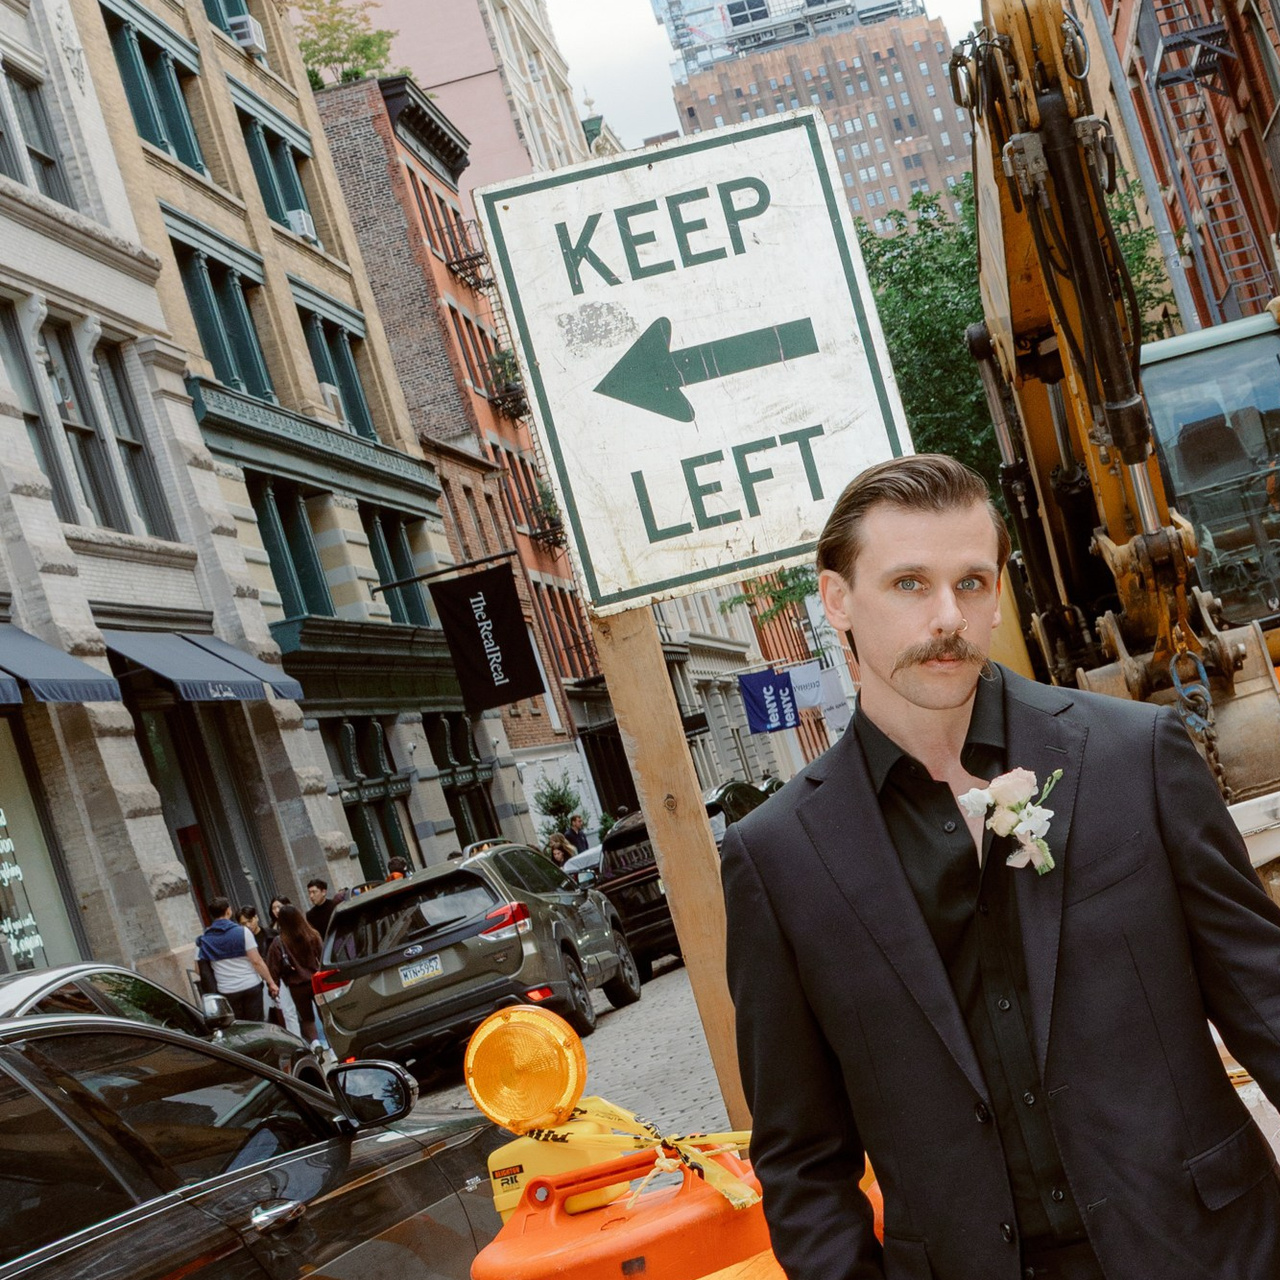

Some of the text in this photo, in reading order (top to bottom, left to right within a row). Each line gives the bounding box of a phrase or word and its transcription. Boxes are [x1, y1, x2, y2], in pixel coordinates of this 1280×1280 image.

[554, 176, 771, 296] KEEP
[630, 424, 825, 544] LEFT
[469, 591, 510, 687] TheRealReal
